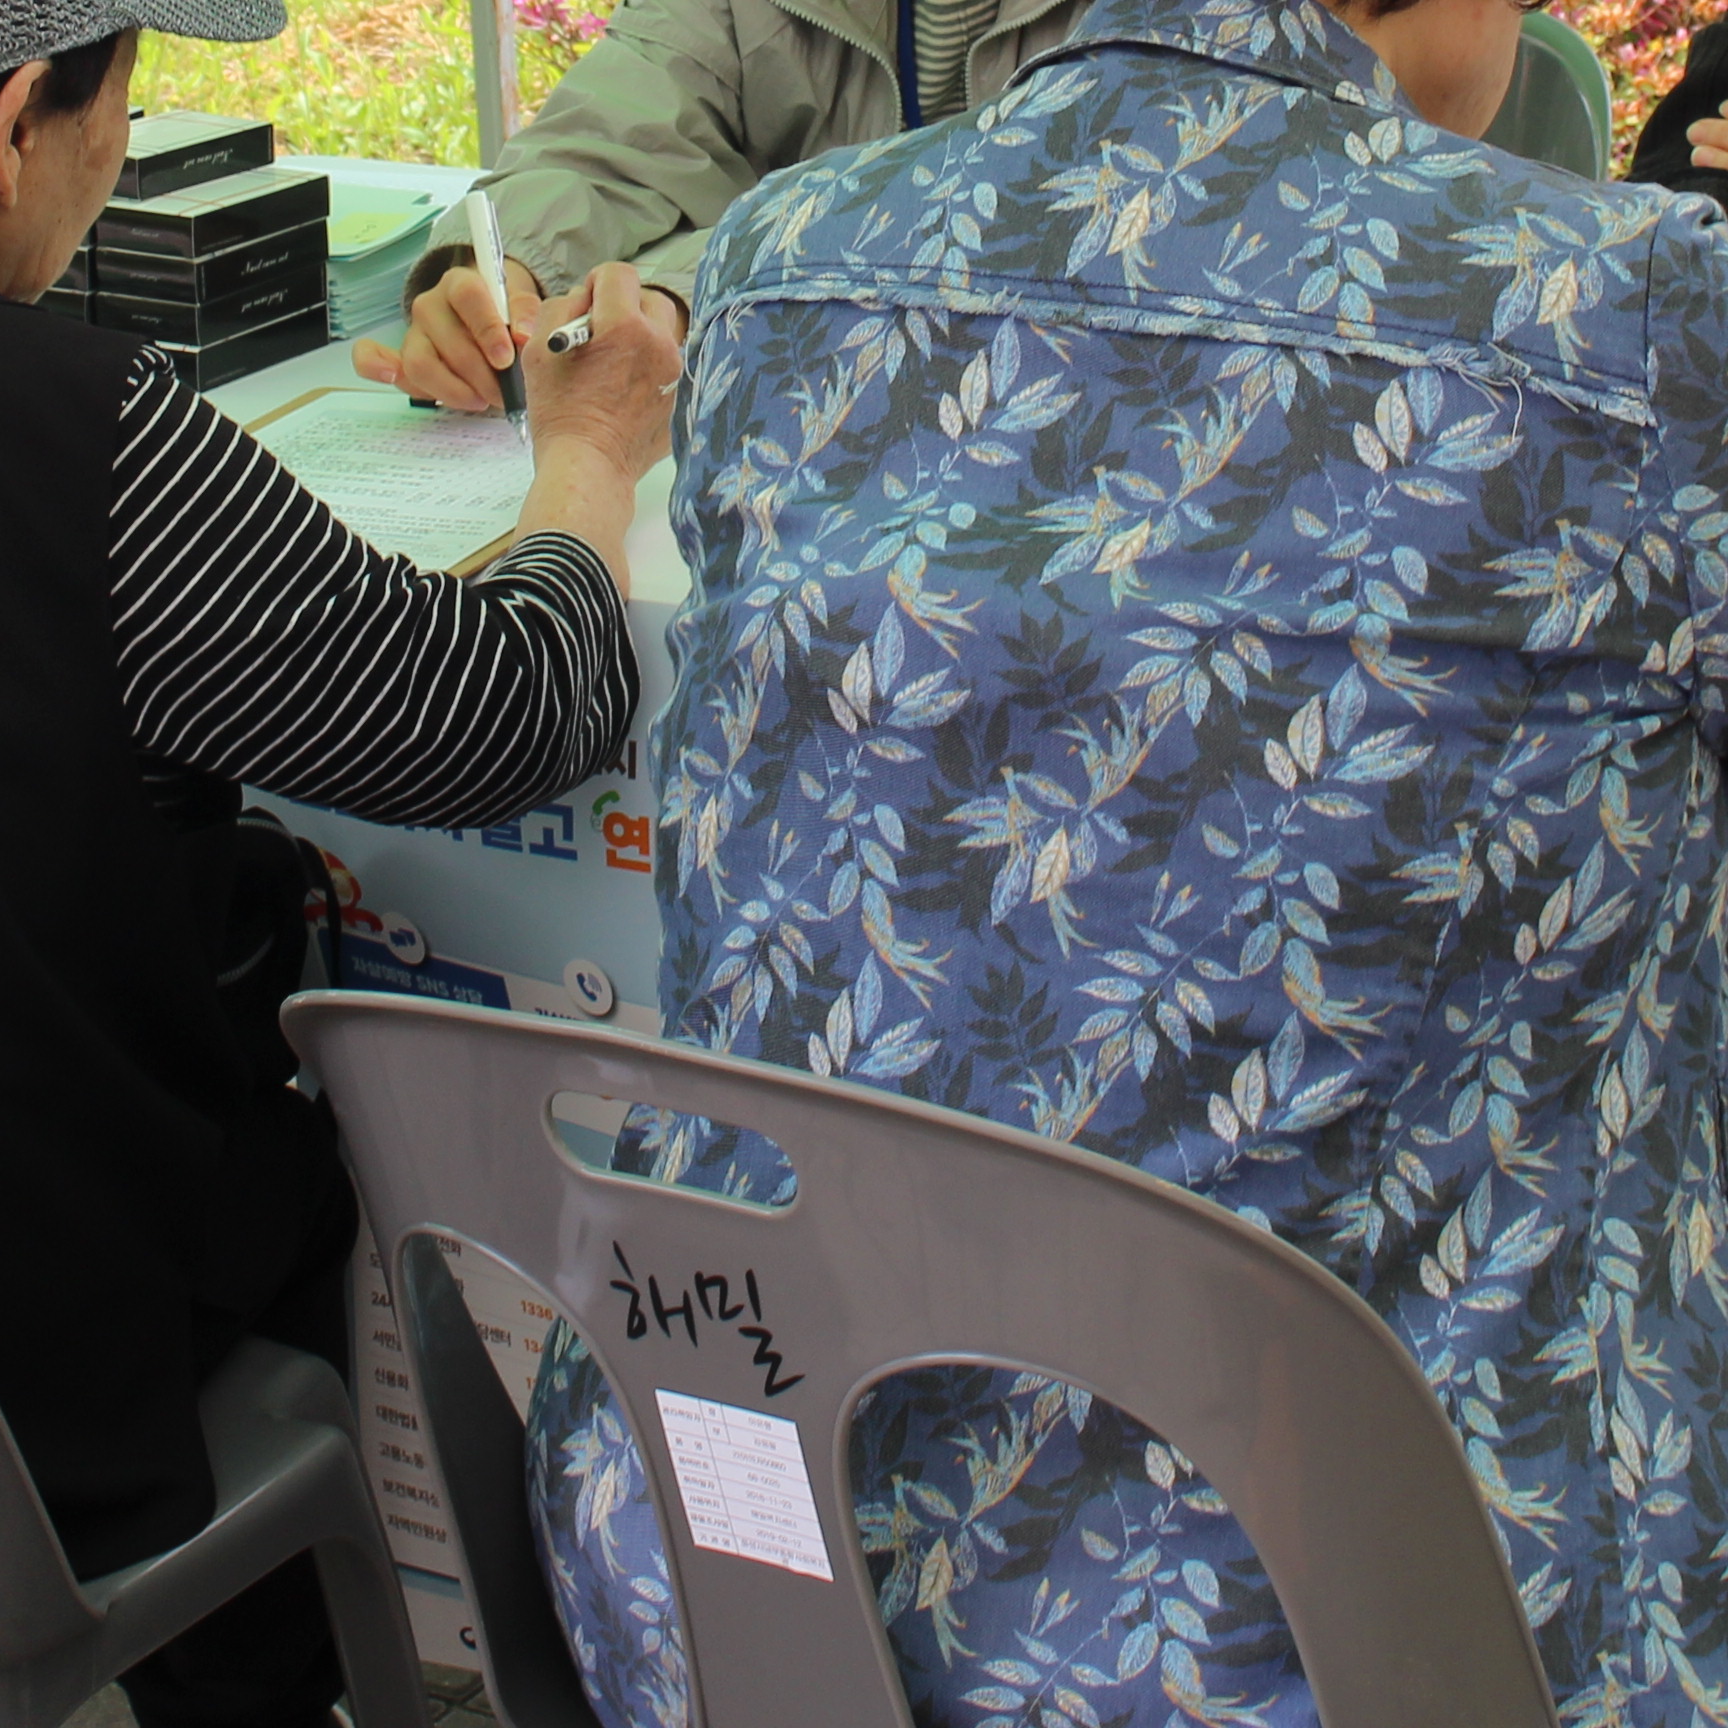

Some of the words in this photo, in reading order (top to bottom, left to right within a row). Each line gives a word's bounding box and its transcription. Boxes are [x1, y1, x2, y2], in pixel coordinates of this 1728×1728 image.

[417, 975, 449, 998] SNS
[521, 1300, 554, 1321] 1336
[610, 1240, 806, 1397] 해밀
